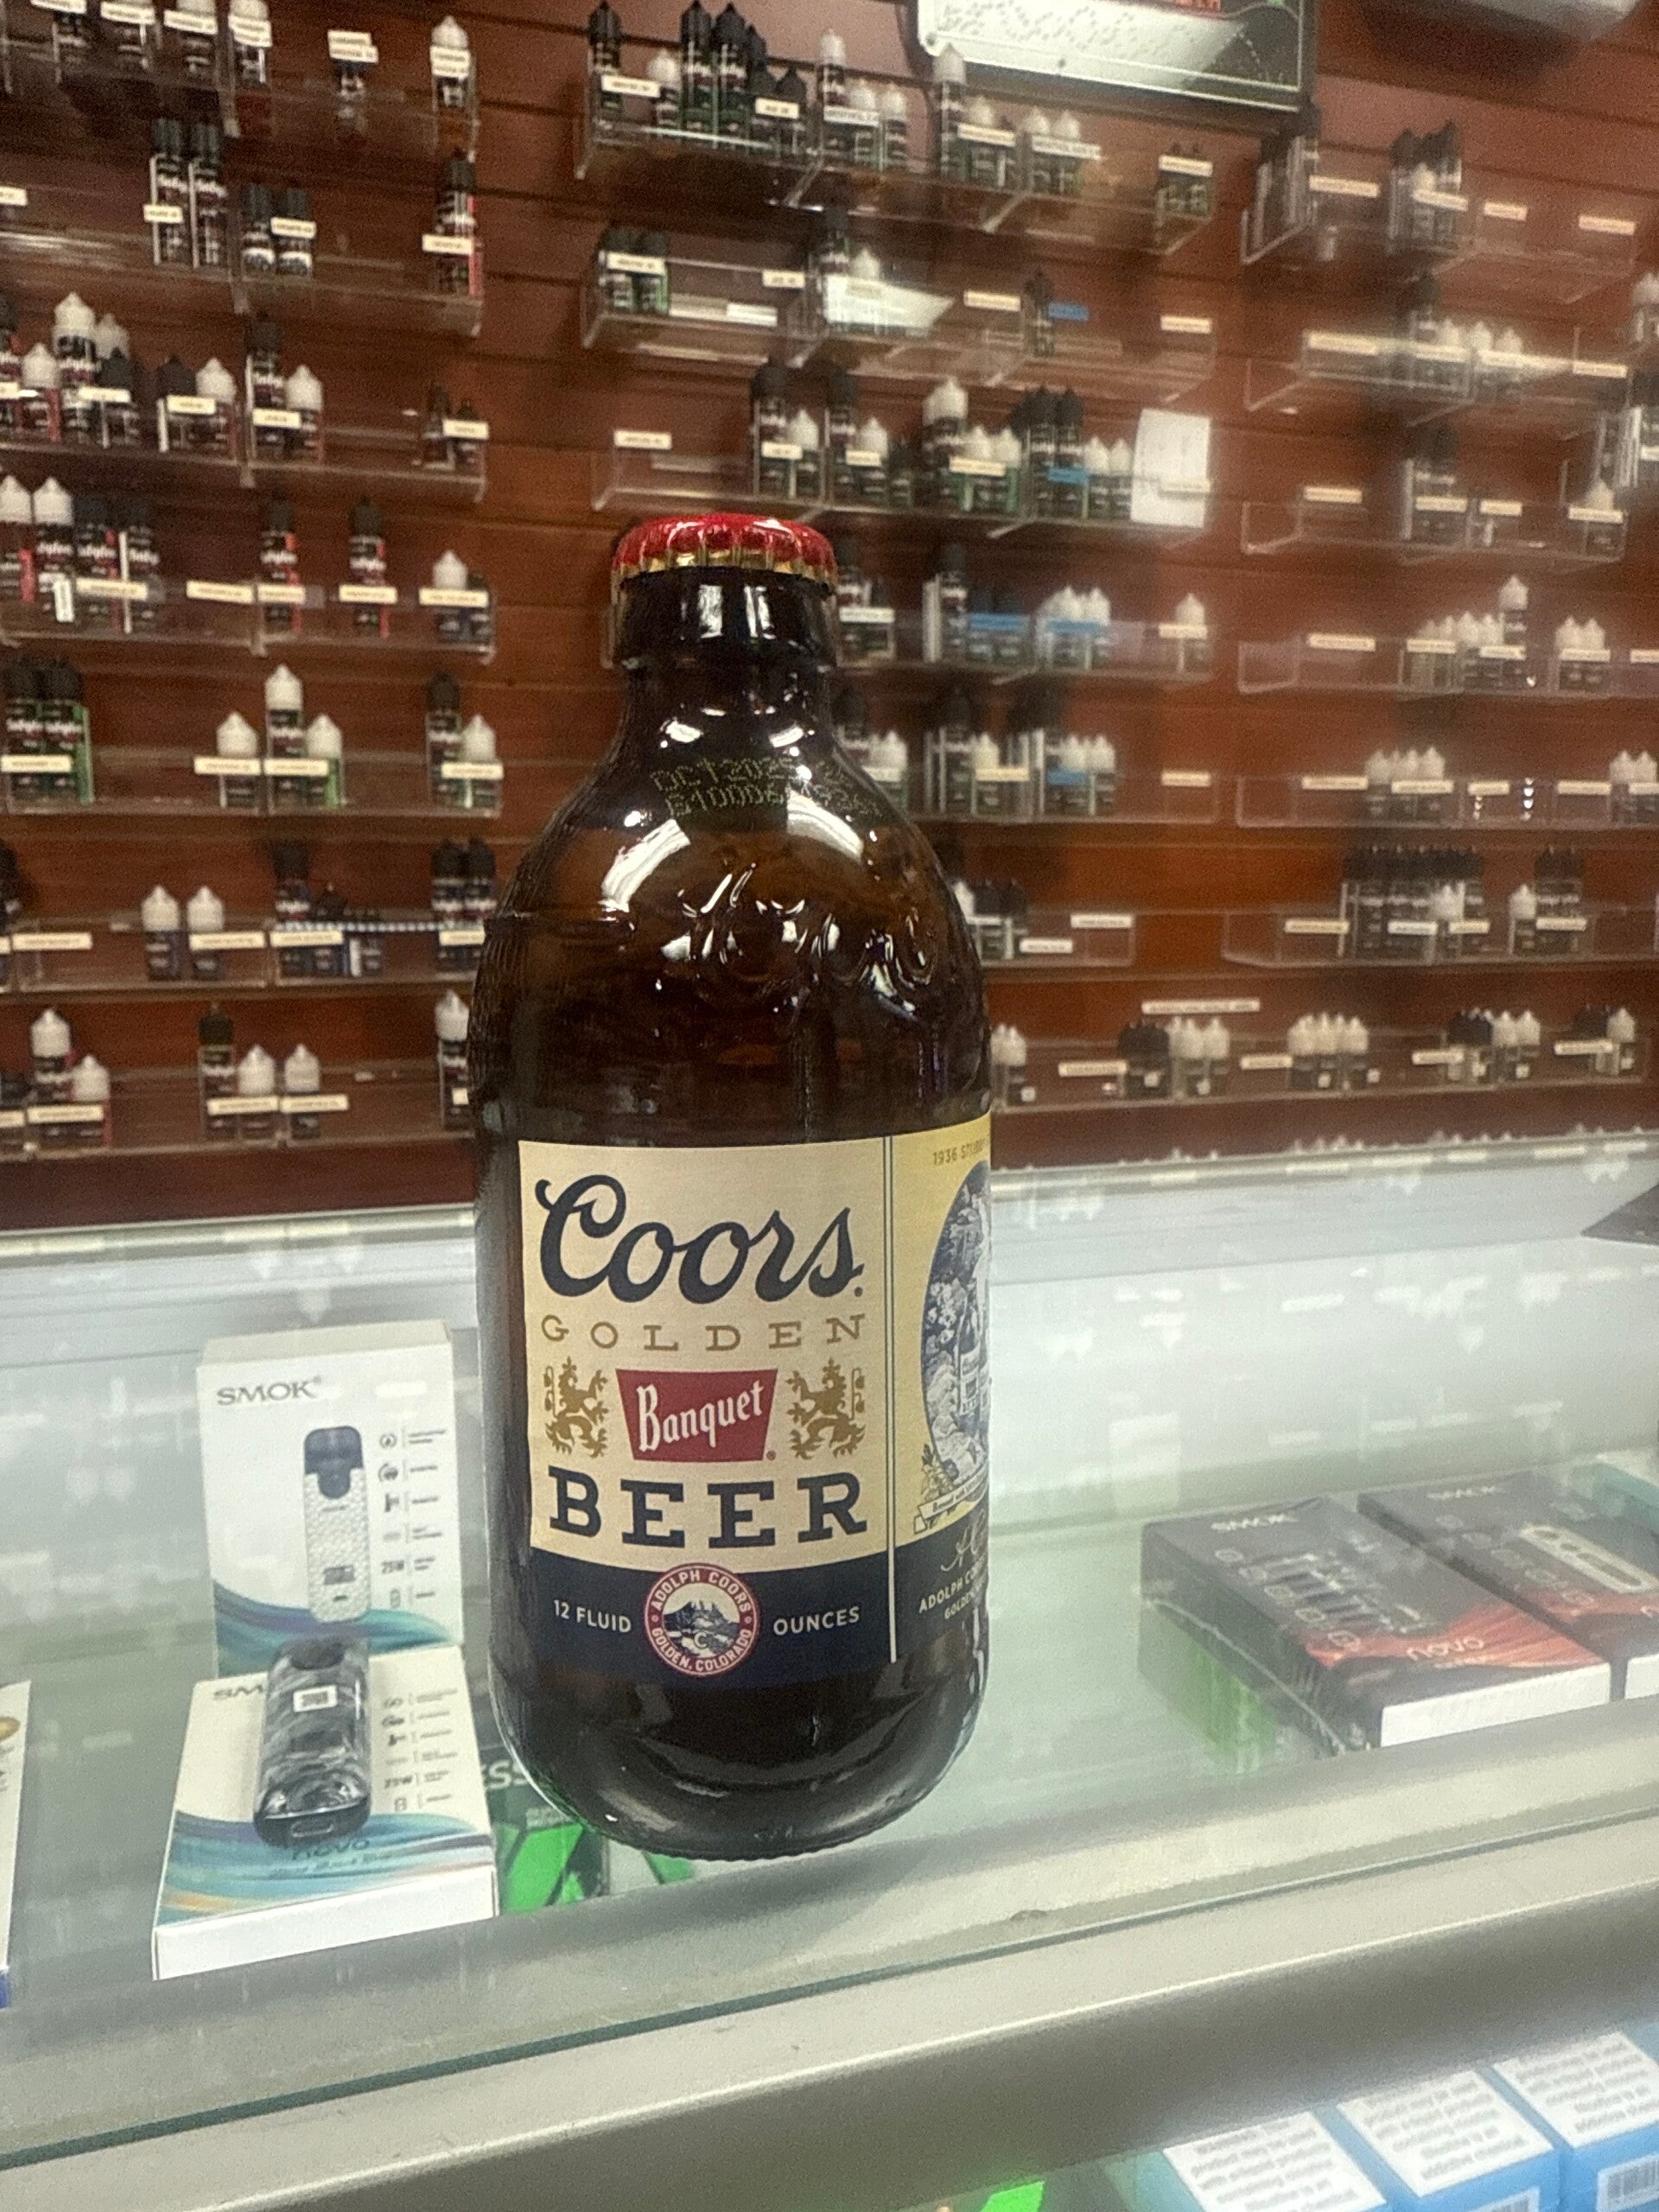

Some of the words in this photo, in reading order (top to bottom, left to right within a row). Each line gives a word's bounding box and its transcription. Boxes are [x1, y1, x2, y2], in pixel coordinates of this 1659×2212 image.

[933, 1147, 957, 1166] 1936
[535, 1173, 865, 1305] Coors
[541, 1313, 866, 1352] GOLDEN
[217, 1381, 317, 1406] SMOK
[636, 1380, 765, 1453] Banquet
[548, 1465, 868, 1549] BEER
[650, 1569, 701, 1612] ADOLPH
[708, 1568, 752, 1613] COORS
[918, 1577, 963, 1614] ADOLPH
[553, 1599, 570, 1619] 12
[576, 1606, 632, 1633] FLUID
[773, 1605, 861, 1636] OUNCES
[695, 1628, 753, 1674] COLORADO
